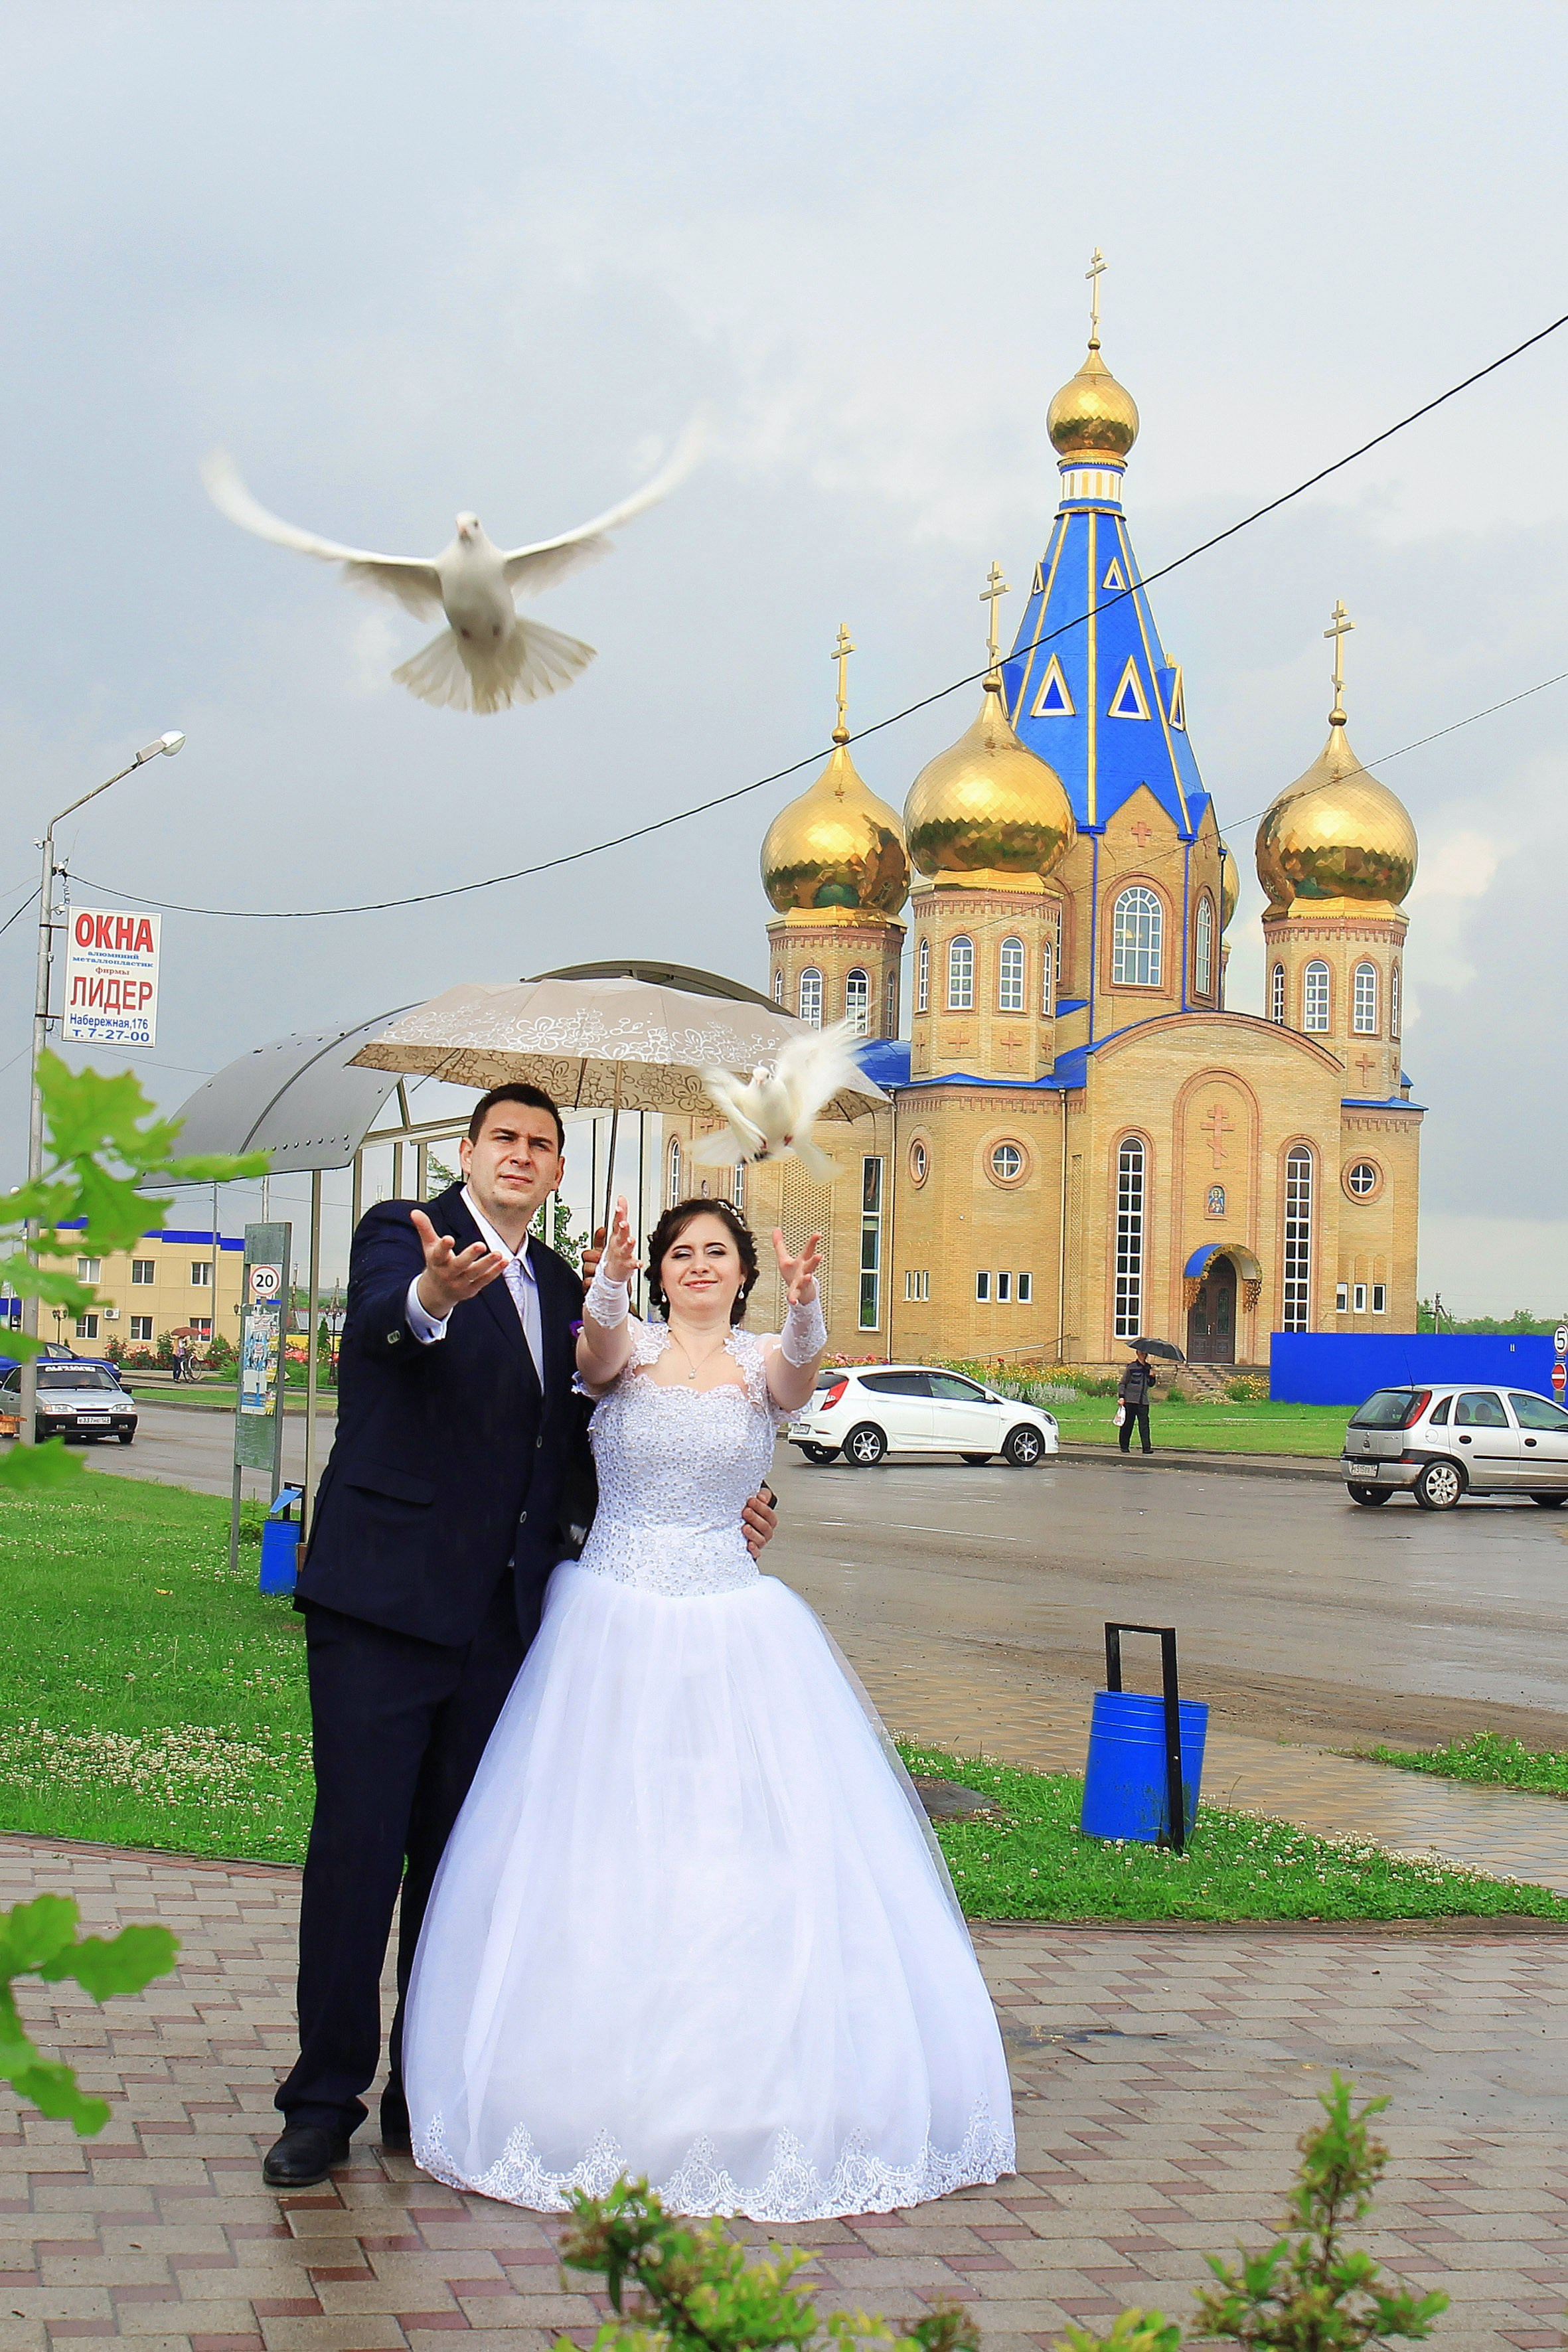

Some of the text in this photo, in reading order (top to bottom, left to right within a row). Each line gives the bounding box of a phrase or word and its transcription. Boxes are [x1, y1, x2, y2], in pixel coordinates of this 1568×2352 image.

[75, 913, 154, 953] ОКНА
[72, 957, 153, 967] металлопластик
[88, 951, 139, 960] алюминий
[95, 967, 130, 975] фирмы
[70, 976, 153, 1015] ЛИДЕР
[88, 1028, 149, 1042] 7-27-00
[256, 1274, 274, 1287] 20
[1557, 1331, 1565, 1350] 5
